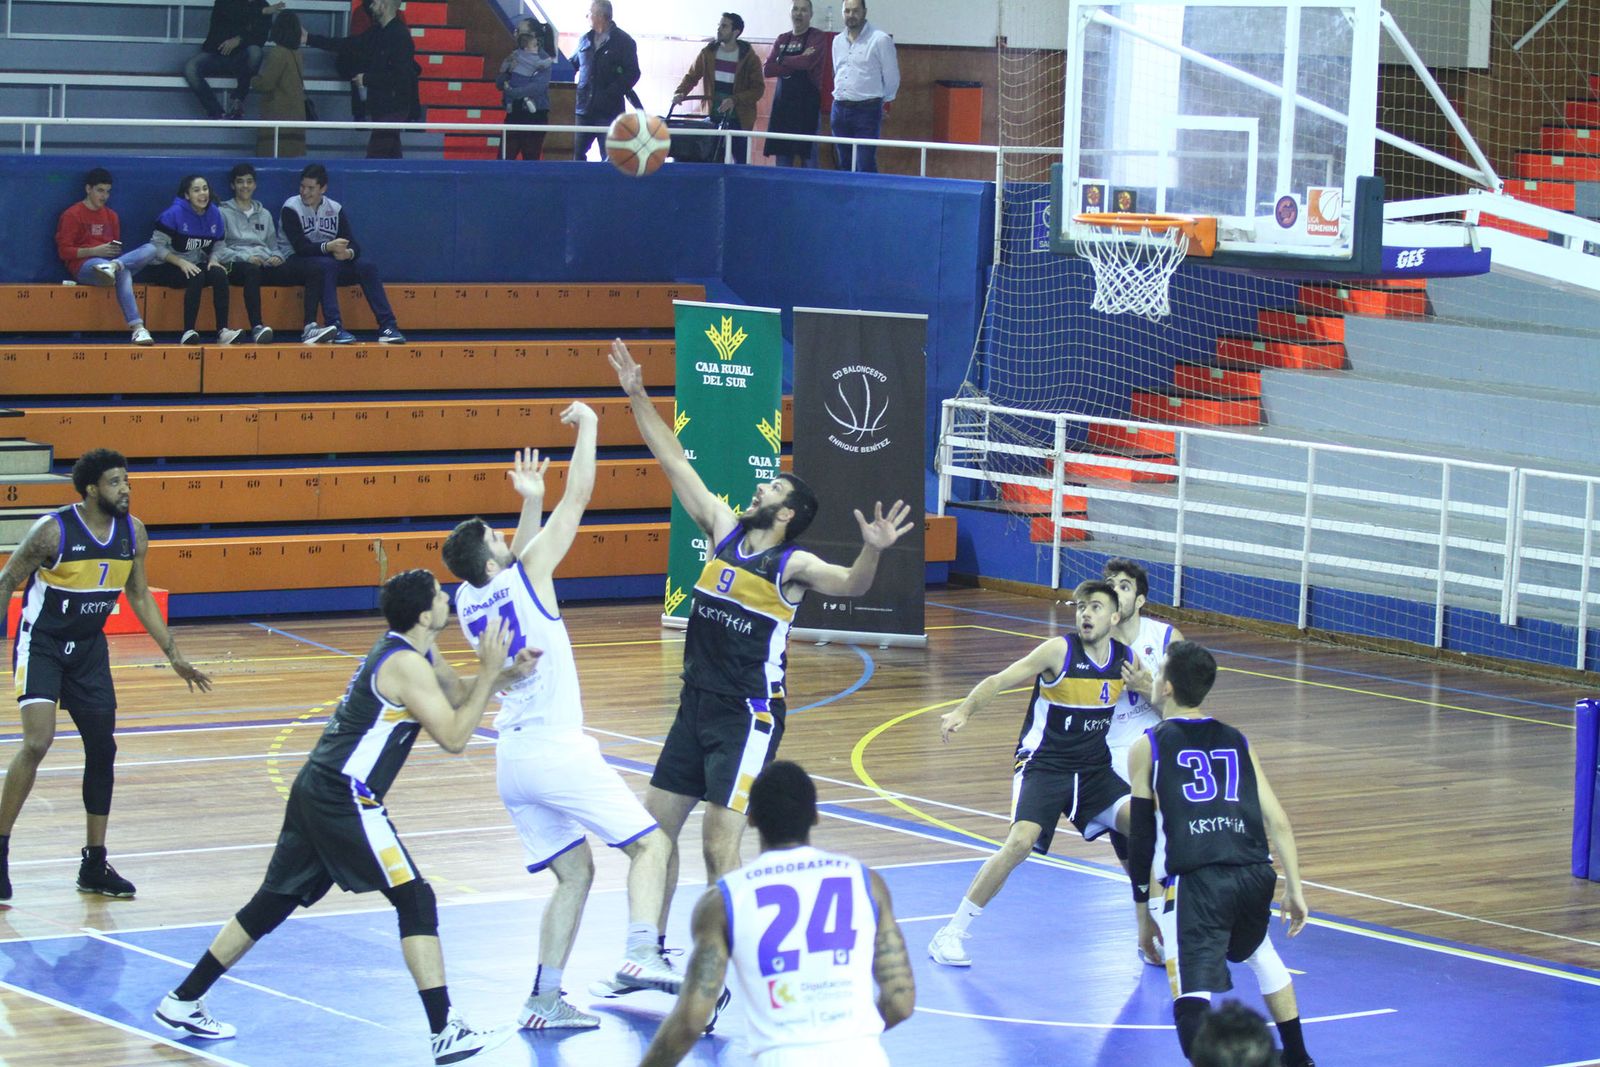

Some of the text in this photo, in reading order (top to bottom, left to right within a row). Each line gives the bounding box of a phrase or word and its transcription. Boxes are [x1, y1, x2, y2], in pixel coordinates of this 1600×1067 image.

[1395, 248, 1427, 269] GES
[404, 290, 415, 298] 72
[456, 290, 466, 298] 74
[507, 290, 518, 298] 76
[558, 290, 569, 298] 78
[72, 352, 84, 360] 58
[245, 352, 257, 360] 64
[300, 352, 312, 360] 66
[356, 351, 368, 359] 68
[410, 350, 421, 358] 70
[463, 349, 474, 357] 72
[515, 349, 526, 357] 74
[568, 348, 579, 357] 76
[695, 362, 754, 376] CAJA RURAL
[832, 365, 887, 383] CD BALONCESTO
[703, 375, 747, 388] DEL SUR
[246, 414, 258, 422] 62
[301, 412, 313, 421] 64
[355, 412, 367, 420] 66
[412, 410, 424, 419] 68
[466, 409, 477, 417] 70
[520, 408, 530, 416] 72
[828, 435, 859, 453] ENRIQUE
[748, 455, 772, 468] CAJA
[188, 468, 647, 489] 58 60 62 64 66 68 74
[755, 469, 777, 480] DEL
[179, 550, 192, 558] 56
[249, 547, 261, 556] 58
[309, 545, 321, 554] 60
[426, 542, 438, 551] 64
[593, 535, 604, 544] 70
[648, 533, 659, 542] 72
[98, 562, 109, 586] 7
[716, 568, 736, 594] 9
[1100, 682, 1110, 704] 4
[1176, 749, 1239, 802] 37
[755, 877, 857, 977] 24
